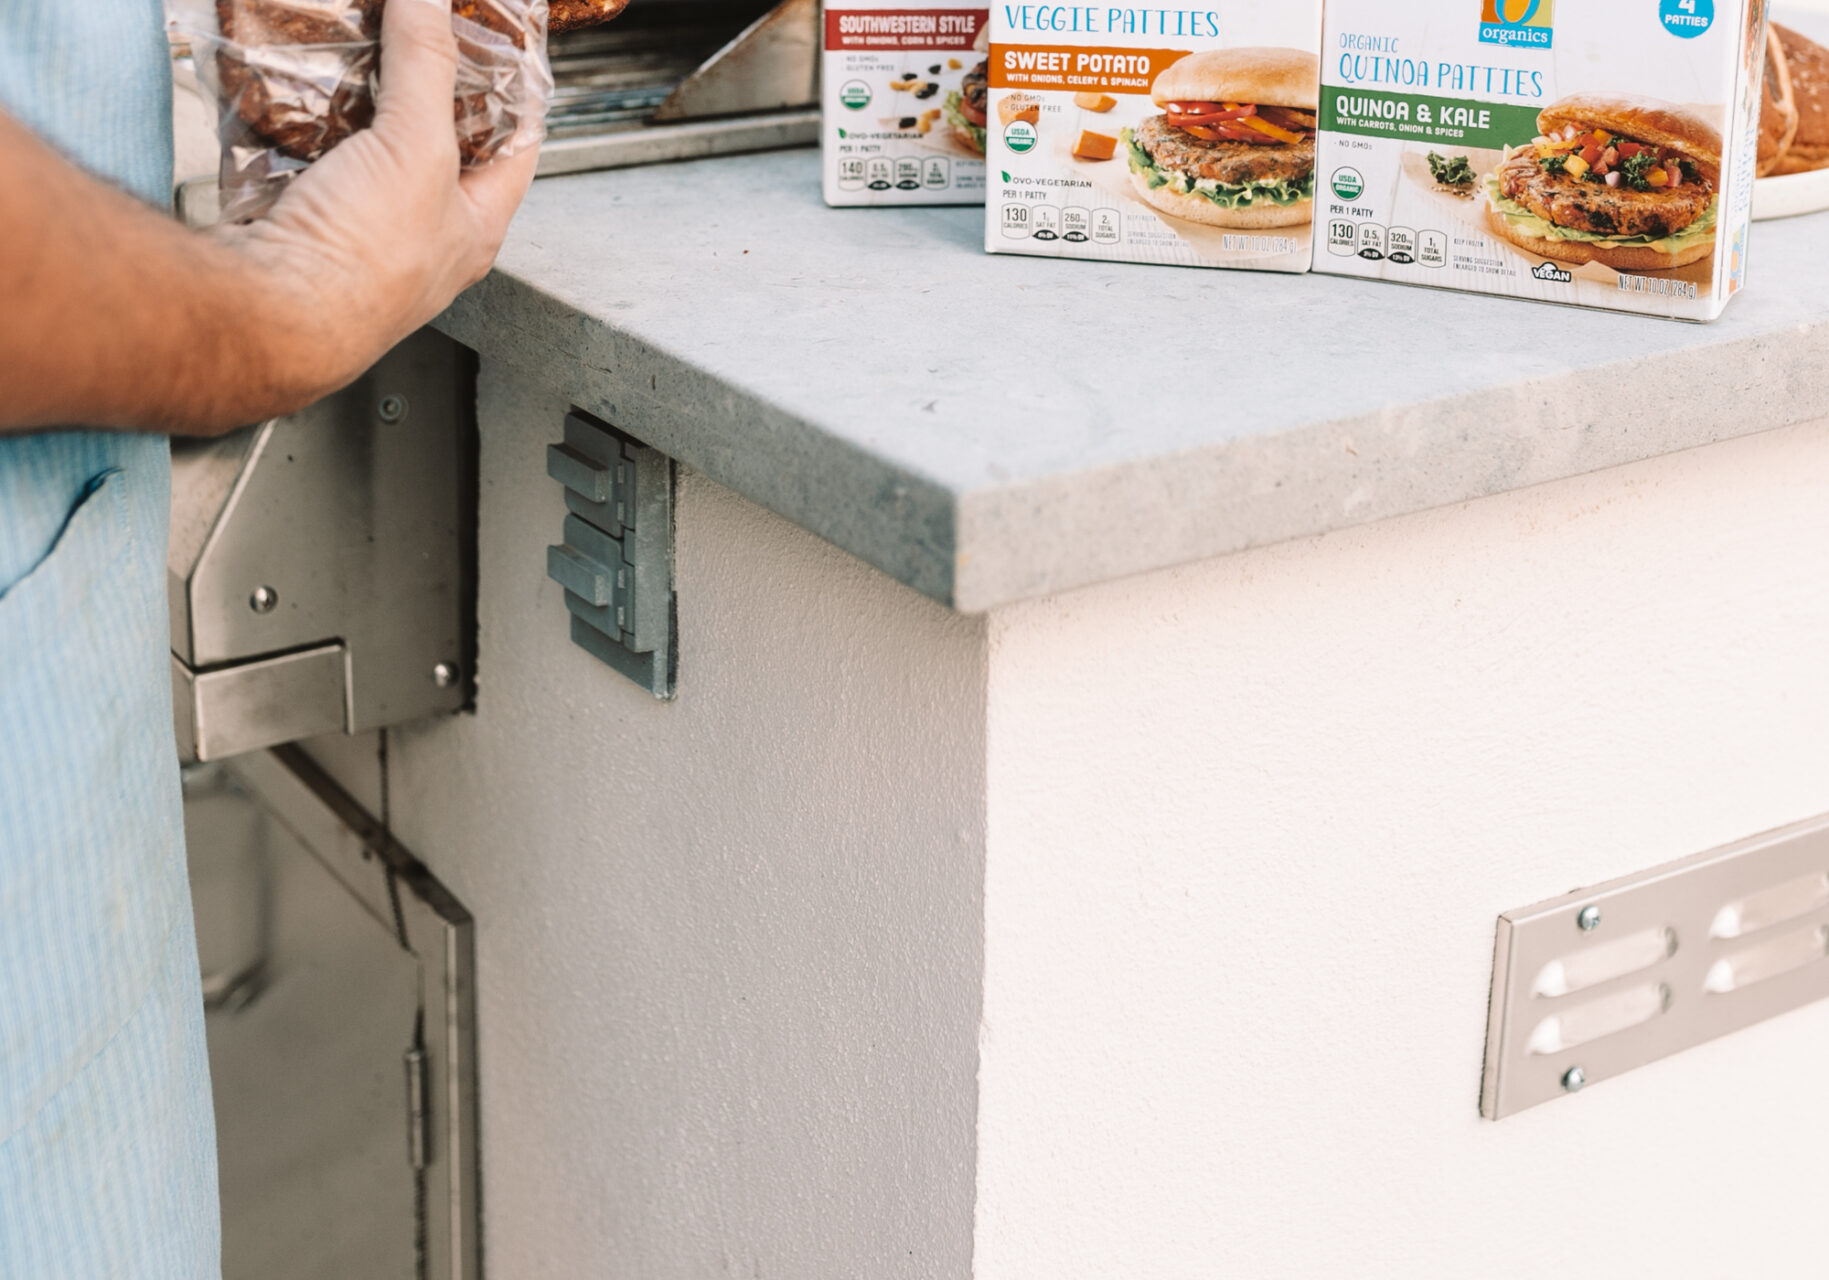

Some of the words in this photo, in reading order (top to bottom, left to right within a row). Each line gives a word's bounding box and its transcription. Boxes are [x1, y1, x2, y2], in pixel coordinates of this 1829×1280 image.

[840, 16, 936, 33] SOUTHWESTERN
[939, 16, 975, 33] STYLE
[1005, 5, 1099, 32] VEGGIE
[1108, 9, 1219, 37] PATTIES
[1665, 14, 1708, 28] PATTIES
[842, 36, 864, 45] WITH
[902, 36, 924, 45] CORN
[936, 36, 965, 45] SPICES
[1483, 26, 1549, 43] organics
[1340, 33, 1399, 53] ORGANIC
[1005, 51, 1071, 72] SWEET
[1077, 54, 1150, 74] POTATO
[1007, 73, 1029, 82] WITH
[1031, 74, 1065, 84] ONIONS,
[1067, 76, 1099, 85] CELERY
[1101, 77, 1108, 85] &
[1111, 78, 1149, 87] SPINACH
[1340, 53, 1429, 86] QUINOA
[1438, 63, 1543, 97] PATTIES
[1010, 94, 1022, 102] NO
[1010, 104, 1039, 112] GLUTEN
[1043, 105, 1061, 113] FREE
[1336, 96, 1409, 120] QUINOA
[1416, 104, 1433, 123] &
[1440, 106, 1490, 128] KALE
[1011, 128, 1030, 136] USDA
[1336, 116, 1357, 126] WITH
[1358, 119, 1397, 131] CARROTS,
[1399, 123, 1424, 134] ONION
[1426, 125, 1433, 134] &
[1435, 127, 1464, 137] SPICES
[1339, 139, 1350, 147] NO
[842, 162, 863, 174] 140
[1013, 177, 1092, 188] OVO-VEGETARIAN
[1338, 174, 1357, 183] USDA
[1003, 190, 1016, 198] PER
[1025, 191, 1047, 200] PATTY
[1005, 208, 1027, 222] 130
[1330, 205, 1344, 214] PER
[1352, 207, 1374, 217] PATTY
[1332, 223, 1353, 239] 130
[1223, 235, 1236, 249] NET
[1238, 236, 1249, 250] WT
[1252, 237, 1260, 251] 10
[1261, 237, 1270, 251] OZ
[1533, 267, 1571, 282] VEGAN
[1619, 274, 1633, 290] NET
[1634, 276, 1646, 291] WT
[1648, 277, 1658, 293] 10
[1659, 279, 1668, 294] OZ
[1671, 280, 1687, 297] (284
[1688, 282, 1697, 300] g)
